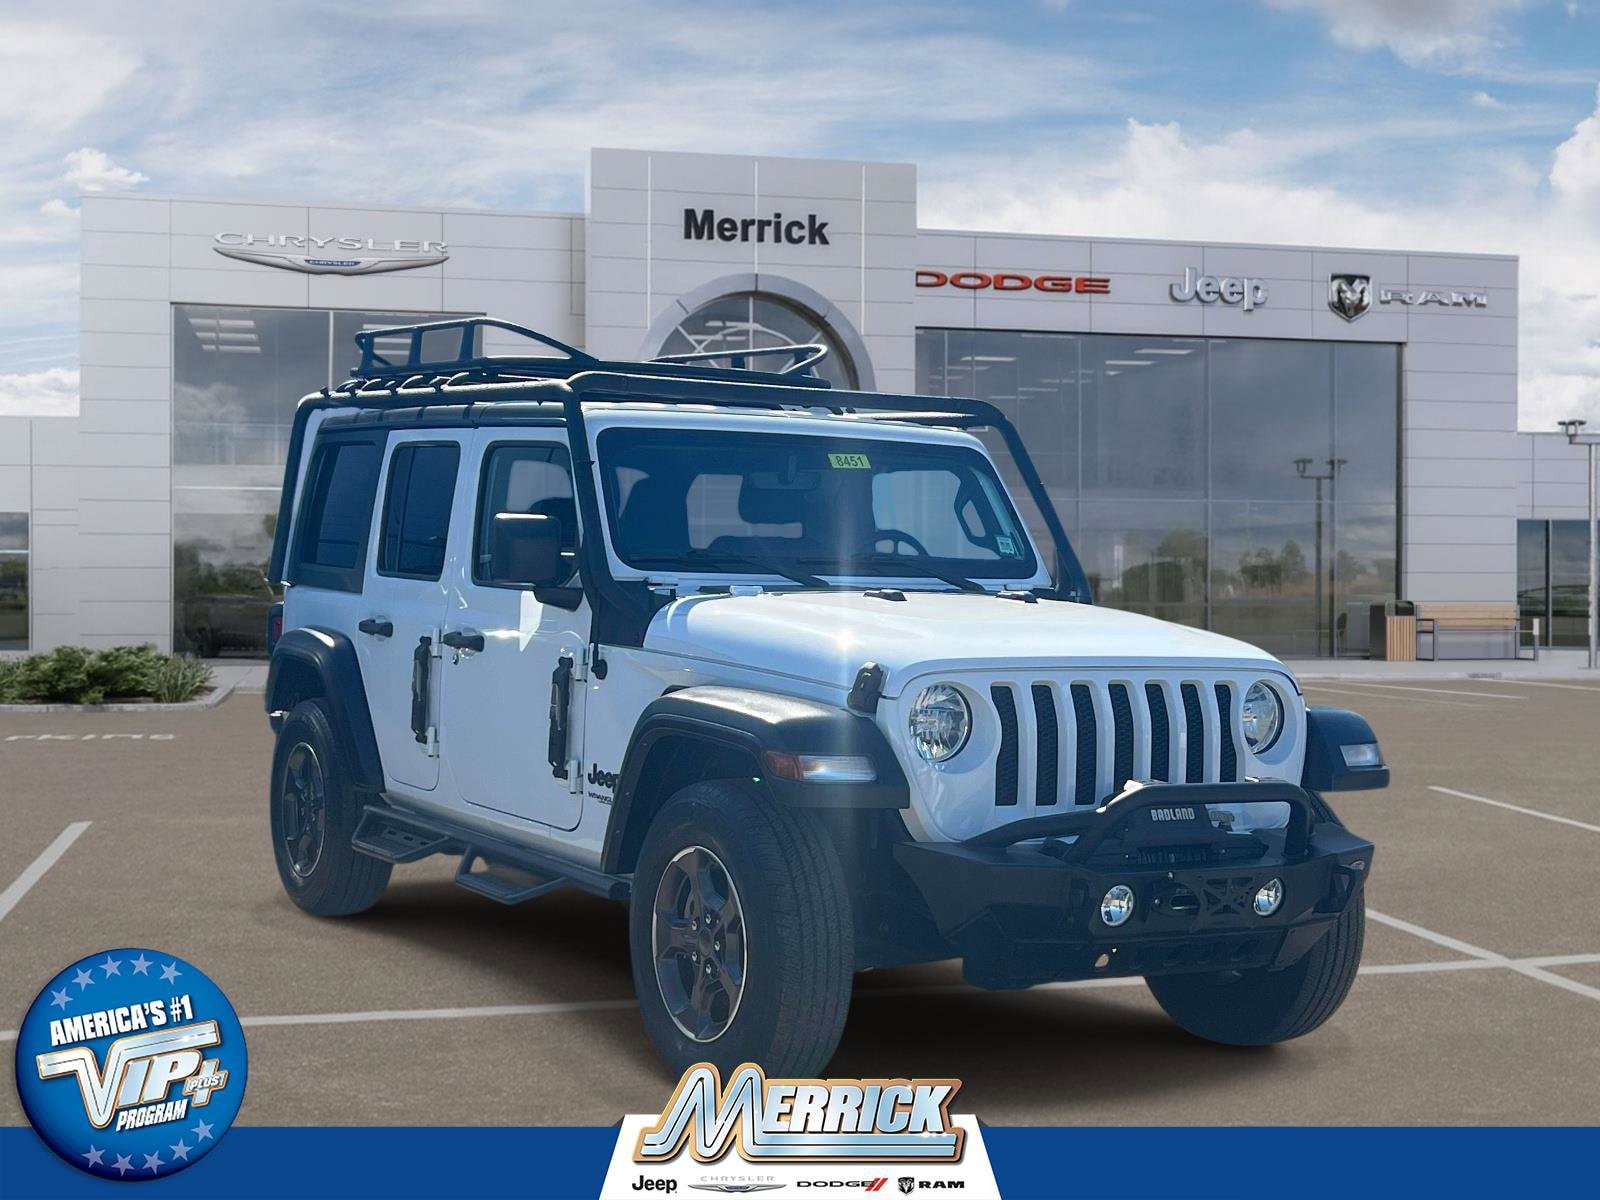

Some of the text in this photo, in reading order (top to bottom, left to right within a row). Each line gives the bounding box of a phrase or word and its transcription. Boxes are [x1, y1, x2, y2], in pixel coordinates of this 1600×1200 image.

[683, 208, 830, 246] Merrick
[214, 231, 450, 254] CHRYSLER
[915, 270, 1111, 295] DODGE
[1169, 266, 1269, 312] Jeep
[1379, 288, 1488, 308] RAM
[835, 455, 865, 467] 8451
[1150, 807, 1196, 821] BADLAND
